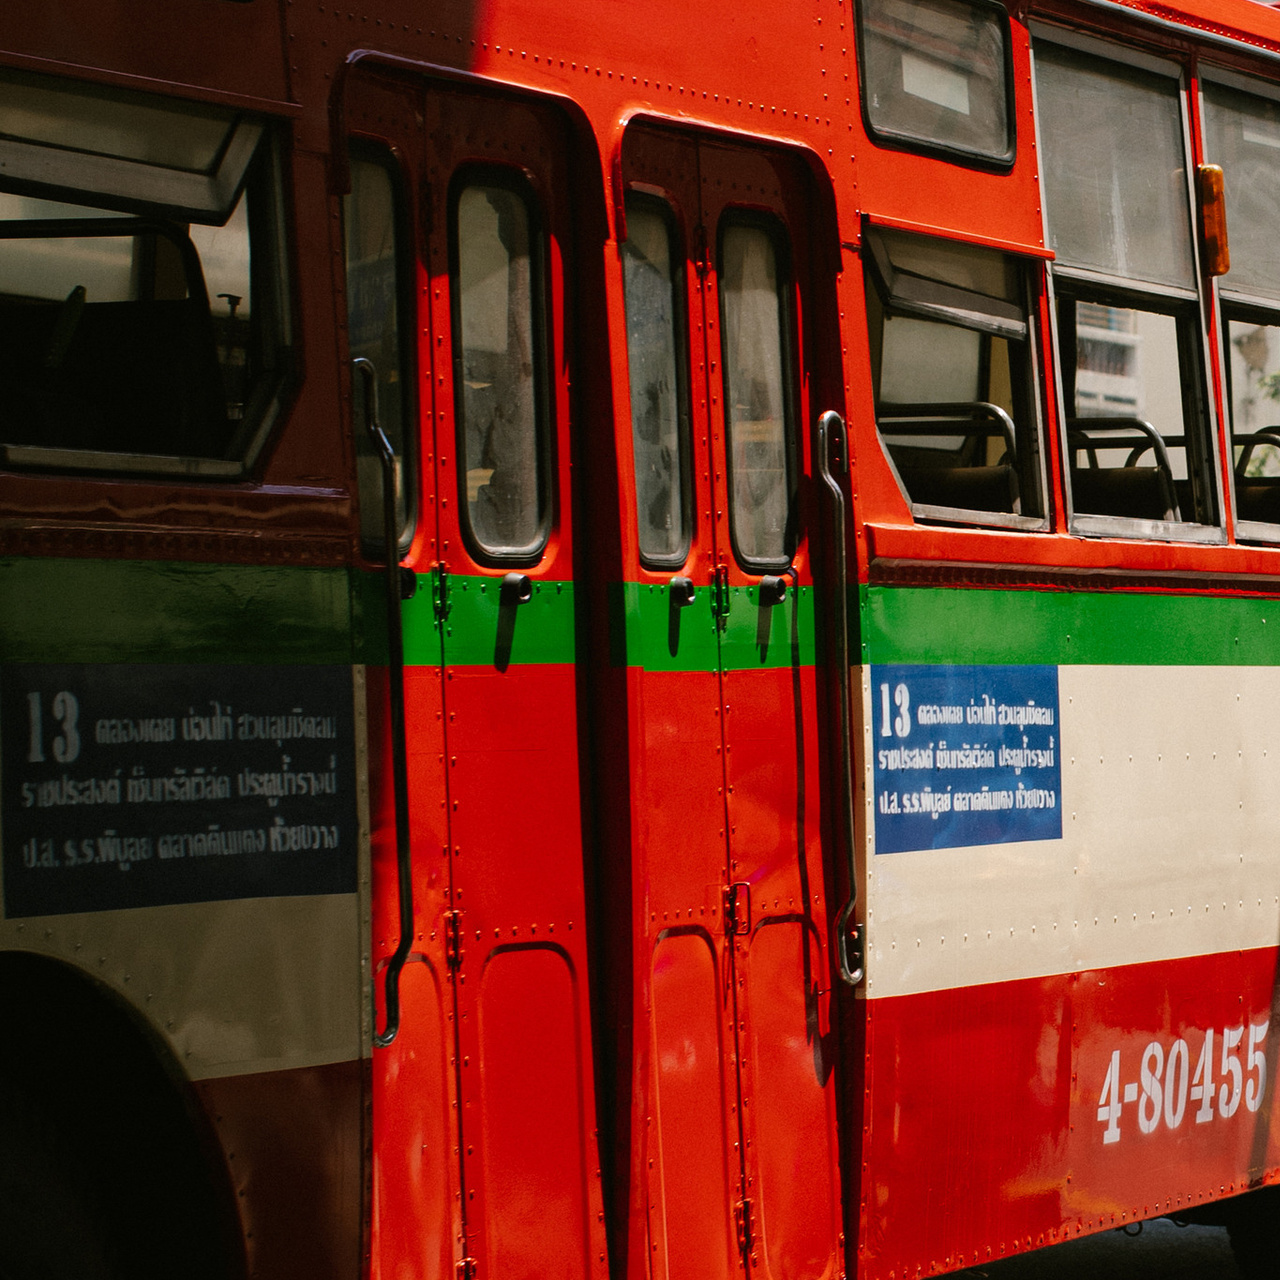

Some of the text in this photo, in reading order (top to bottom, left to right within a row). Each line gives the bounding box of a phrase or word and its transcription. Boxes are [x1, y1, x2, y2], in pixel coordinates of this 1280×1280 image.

[27, 690, 80, 763] 13
[95, 718, 175, 744] คลองเตย
[182, 701, 234, 741] บ่อนไก่
[880, 683, 911, 737] 13
[966, 694, 997, 725] บ่อนไก่
[1015, 782, 1056, 809] ห้วยขวาง
[1097, 1020, 1270, 1145] 4-80455
